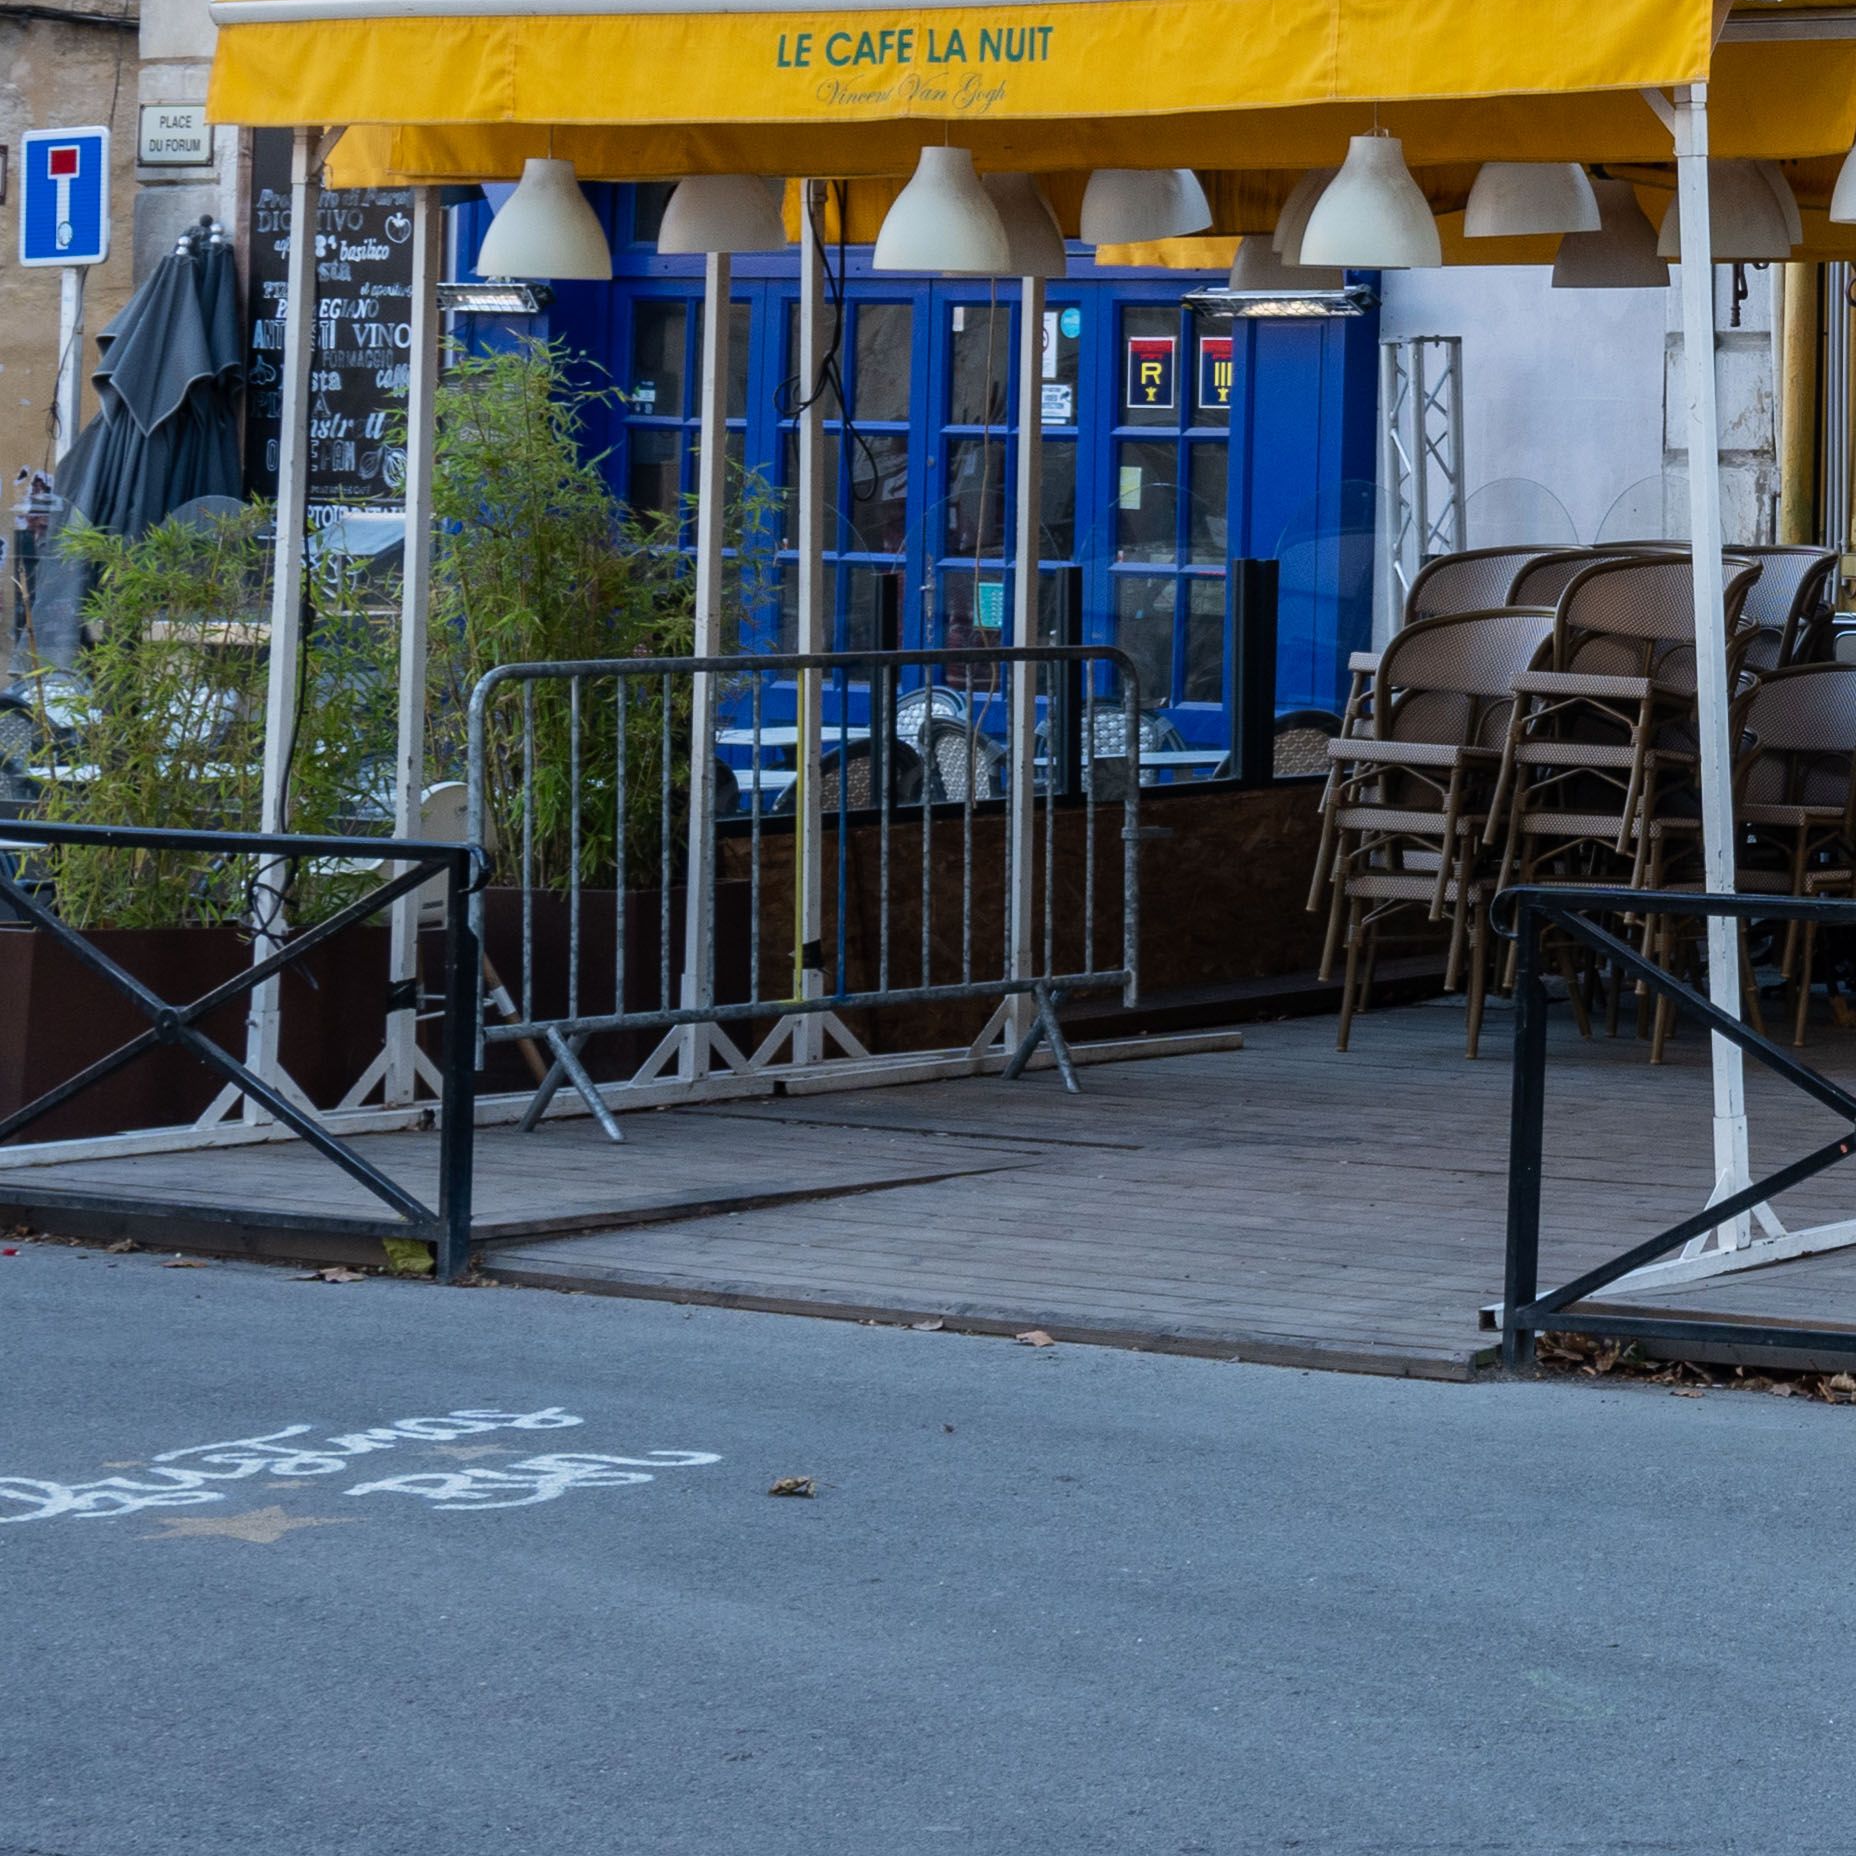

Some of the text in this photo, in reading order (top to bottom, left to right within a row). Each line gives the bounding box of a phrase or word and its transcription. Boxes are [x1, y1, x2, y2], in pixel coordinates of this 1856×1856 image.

[776, 25, 1055, 69] LE CAFE LA NUIT
[159, 114, 192, 129] PLACE
[149, 138, 201, 153] DU FORUM
[339, 236, 390, 262] basilico
[351, 322, 412, 349] VINO
[1141, 362, 1162, 384] R
